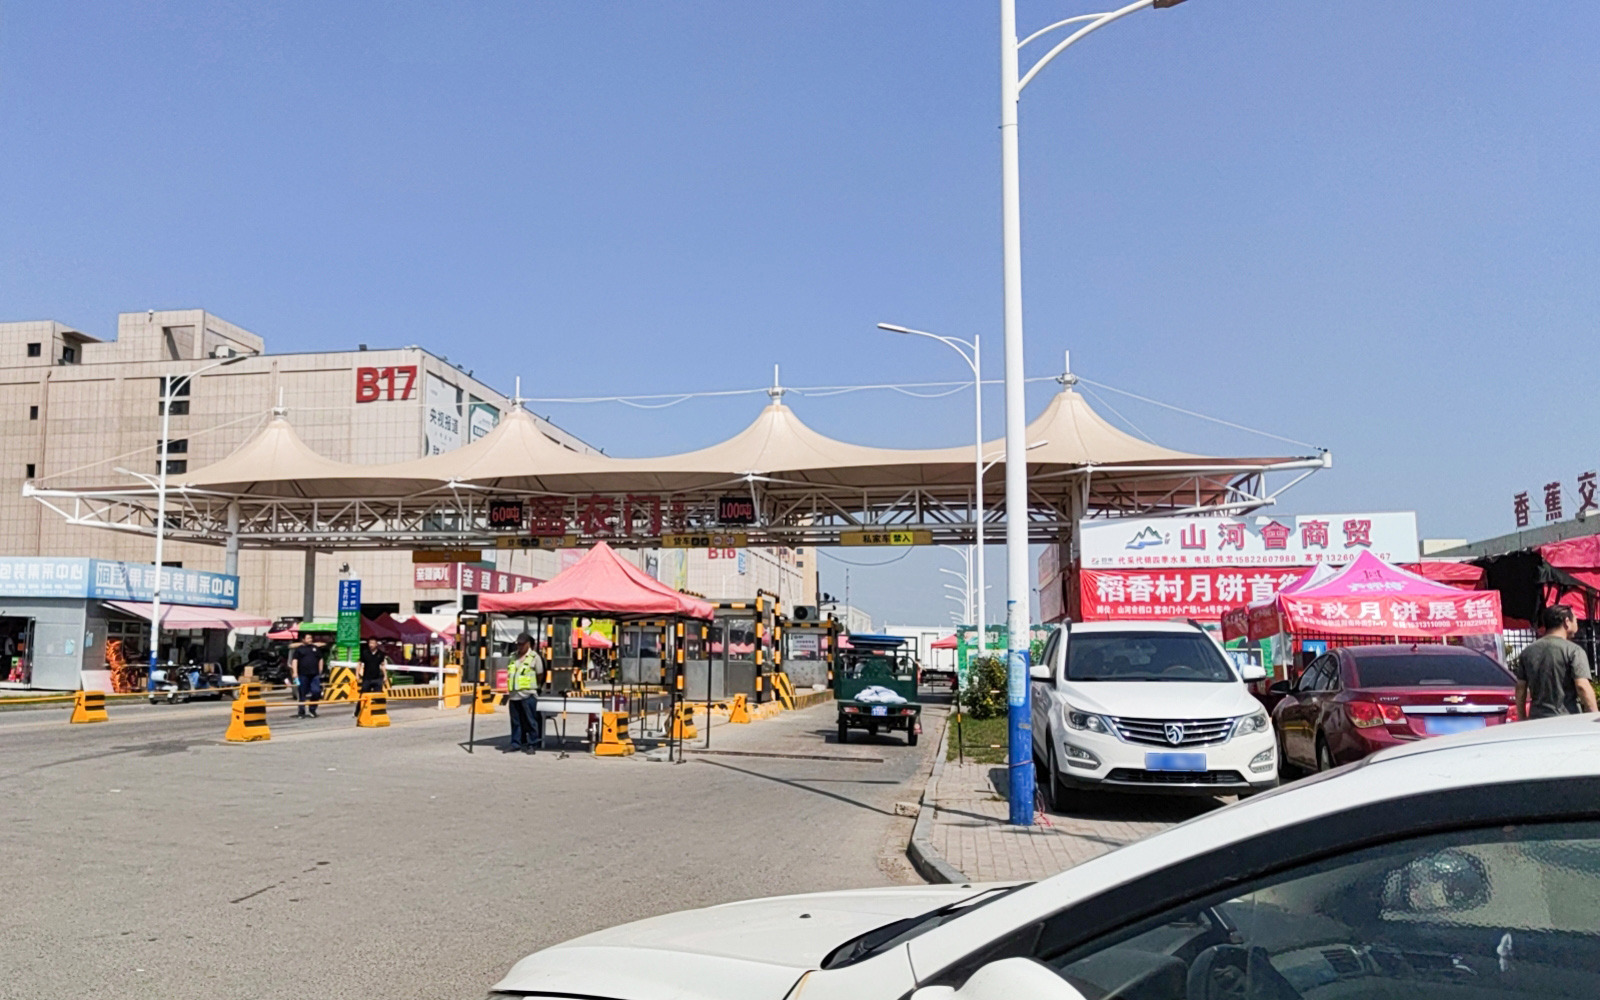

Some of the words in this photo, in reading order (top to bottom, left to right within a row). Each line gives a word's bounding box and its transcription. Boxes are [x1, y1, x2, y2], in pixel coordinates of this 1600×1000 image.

[356, 365, 417, 403] B17
[430, 408, 459, 435] 央视报道
[492, 505, 520, 523] 60吨
[720, 502, 753, 521] 100吨
[1288, 599, 1494, 621] 中秋月饼展销
